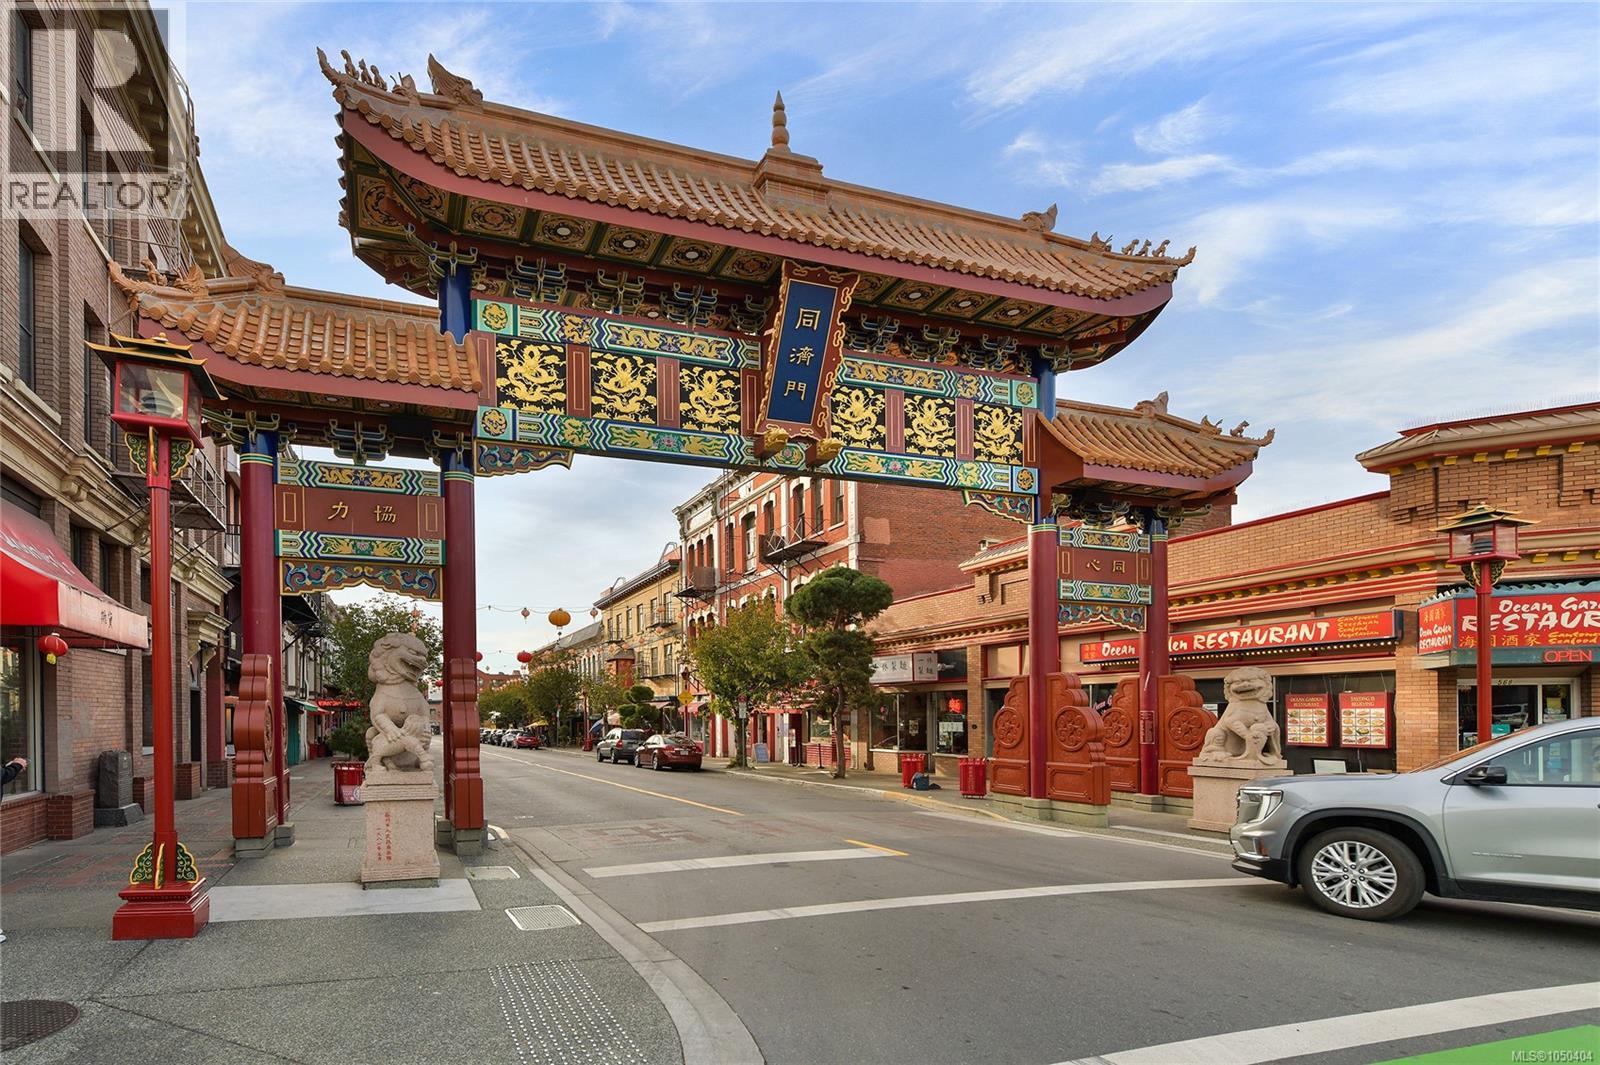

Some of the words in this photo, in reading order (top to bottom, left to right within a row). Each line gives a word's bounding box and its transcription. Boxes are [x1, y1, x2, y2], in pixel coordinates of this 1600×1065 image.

[784, 308, 821, 401] 同濟門
[1499, 600, 1553, 613] Ocean
[1560, 596, 1600, 611] Gar
[1101, 642, 1136, 657] Ocean
[1193, 622, 1331, 650] RESTAURANT
[1544, 649, 1593, 663] OPEN
